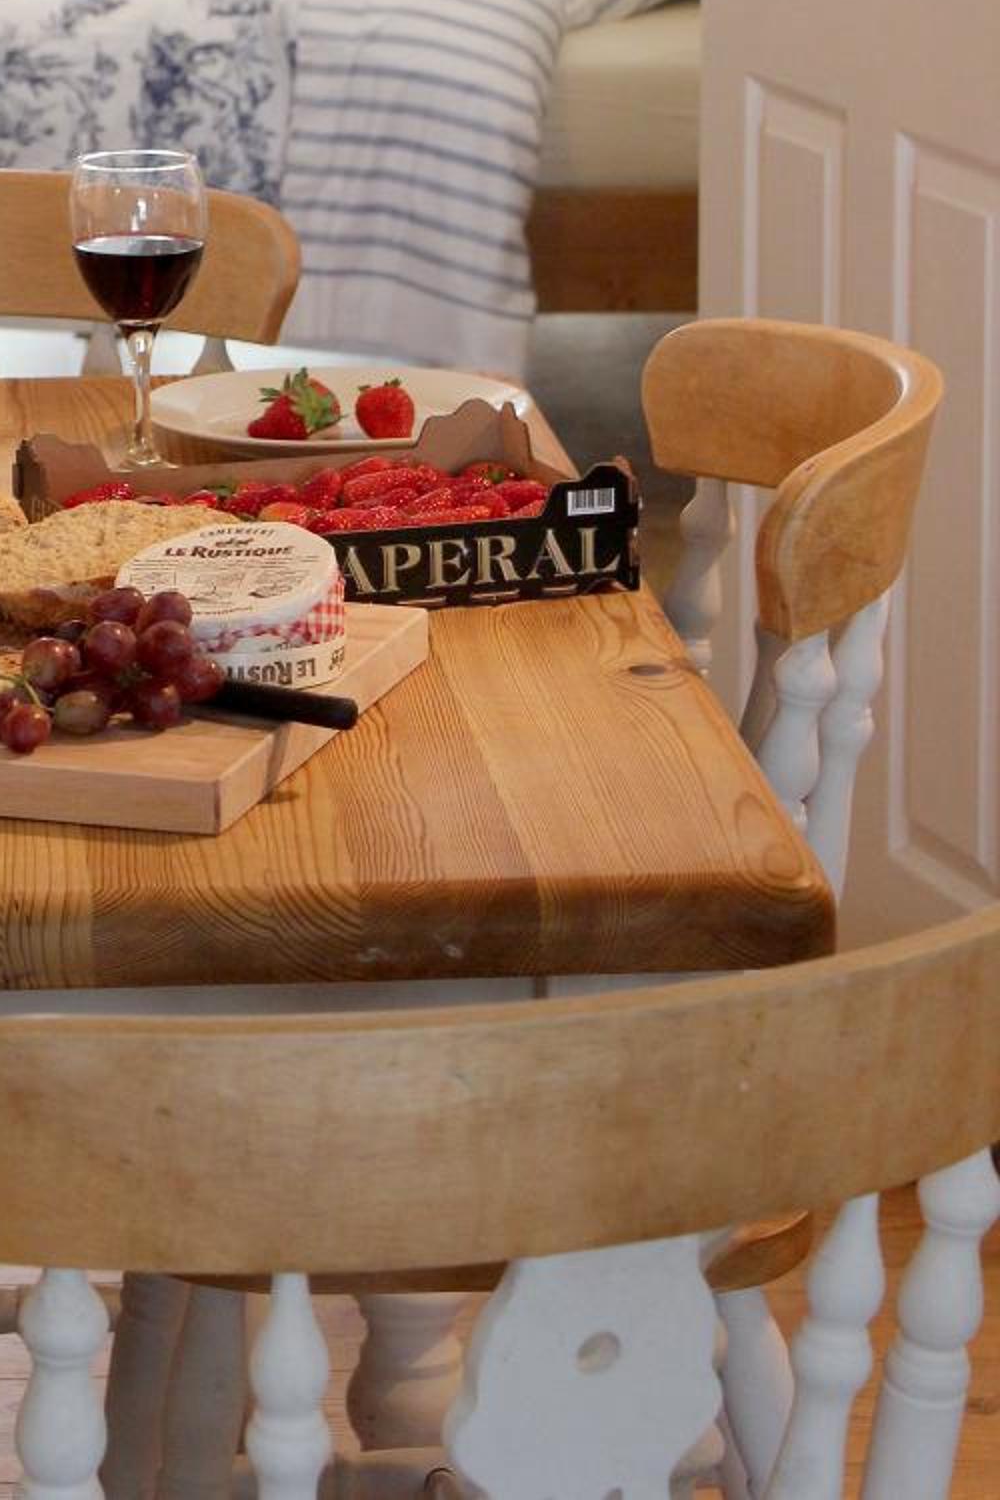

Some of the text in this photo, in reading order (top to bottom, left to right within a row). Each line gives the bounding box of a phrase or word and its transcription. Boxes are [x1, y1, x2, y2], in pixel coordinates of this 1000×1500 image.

[164, 547, 185, 557] LE
[189, 545, 296, 559] RUSTIQUE
[344, 526, 622, 596] APERAL
[226, 661, 293, 685] RUSTI
[296, 657, 316, 677] LE
